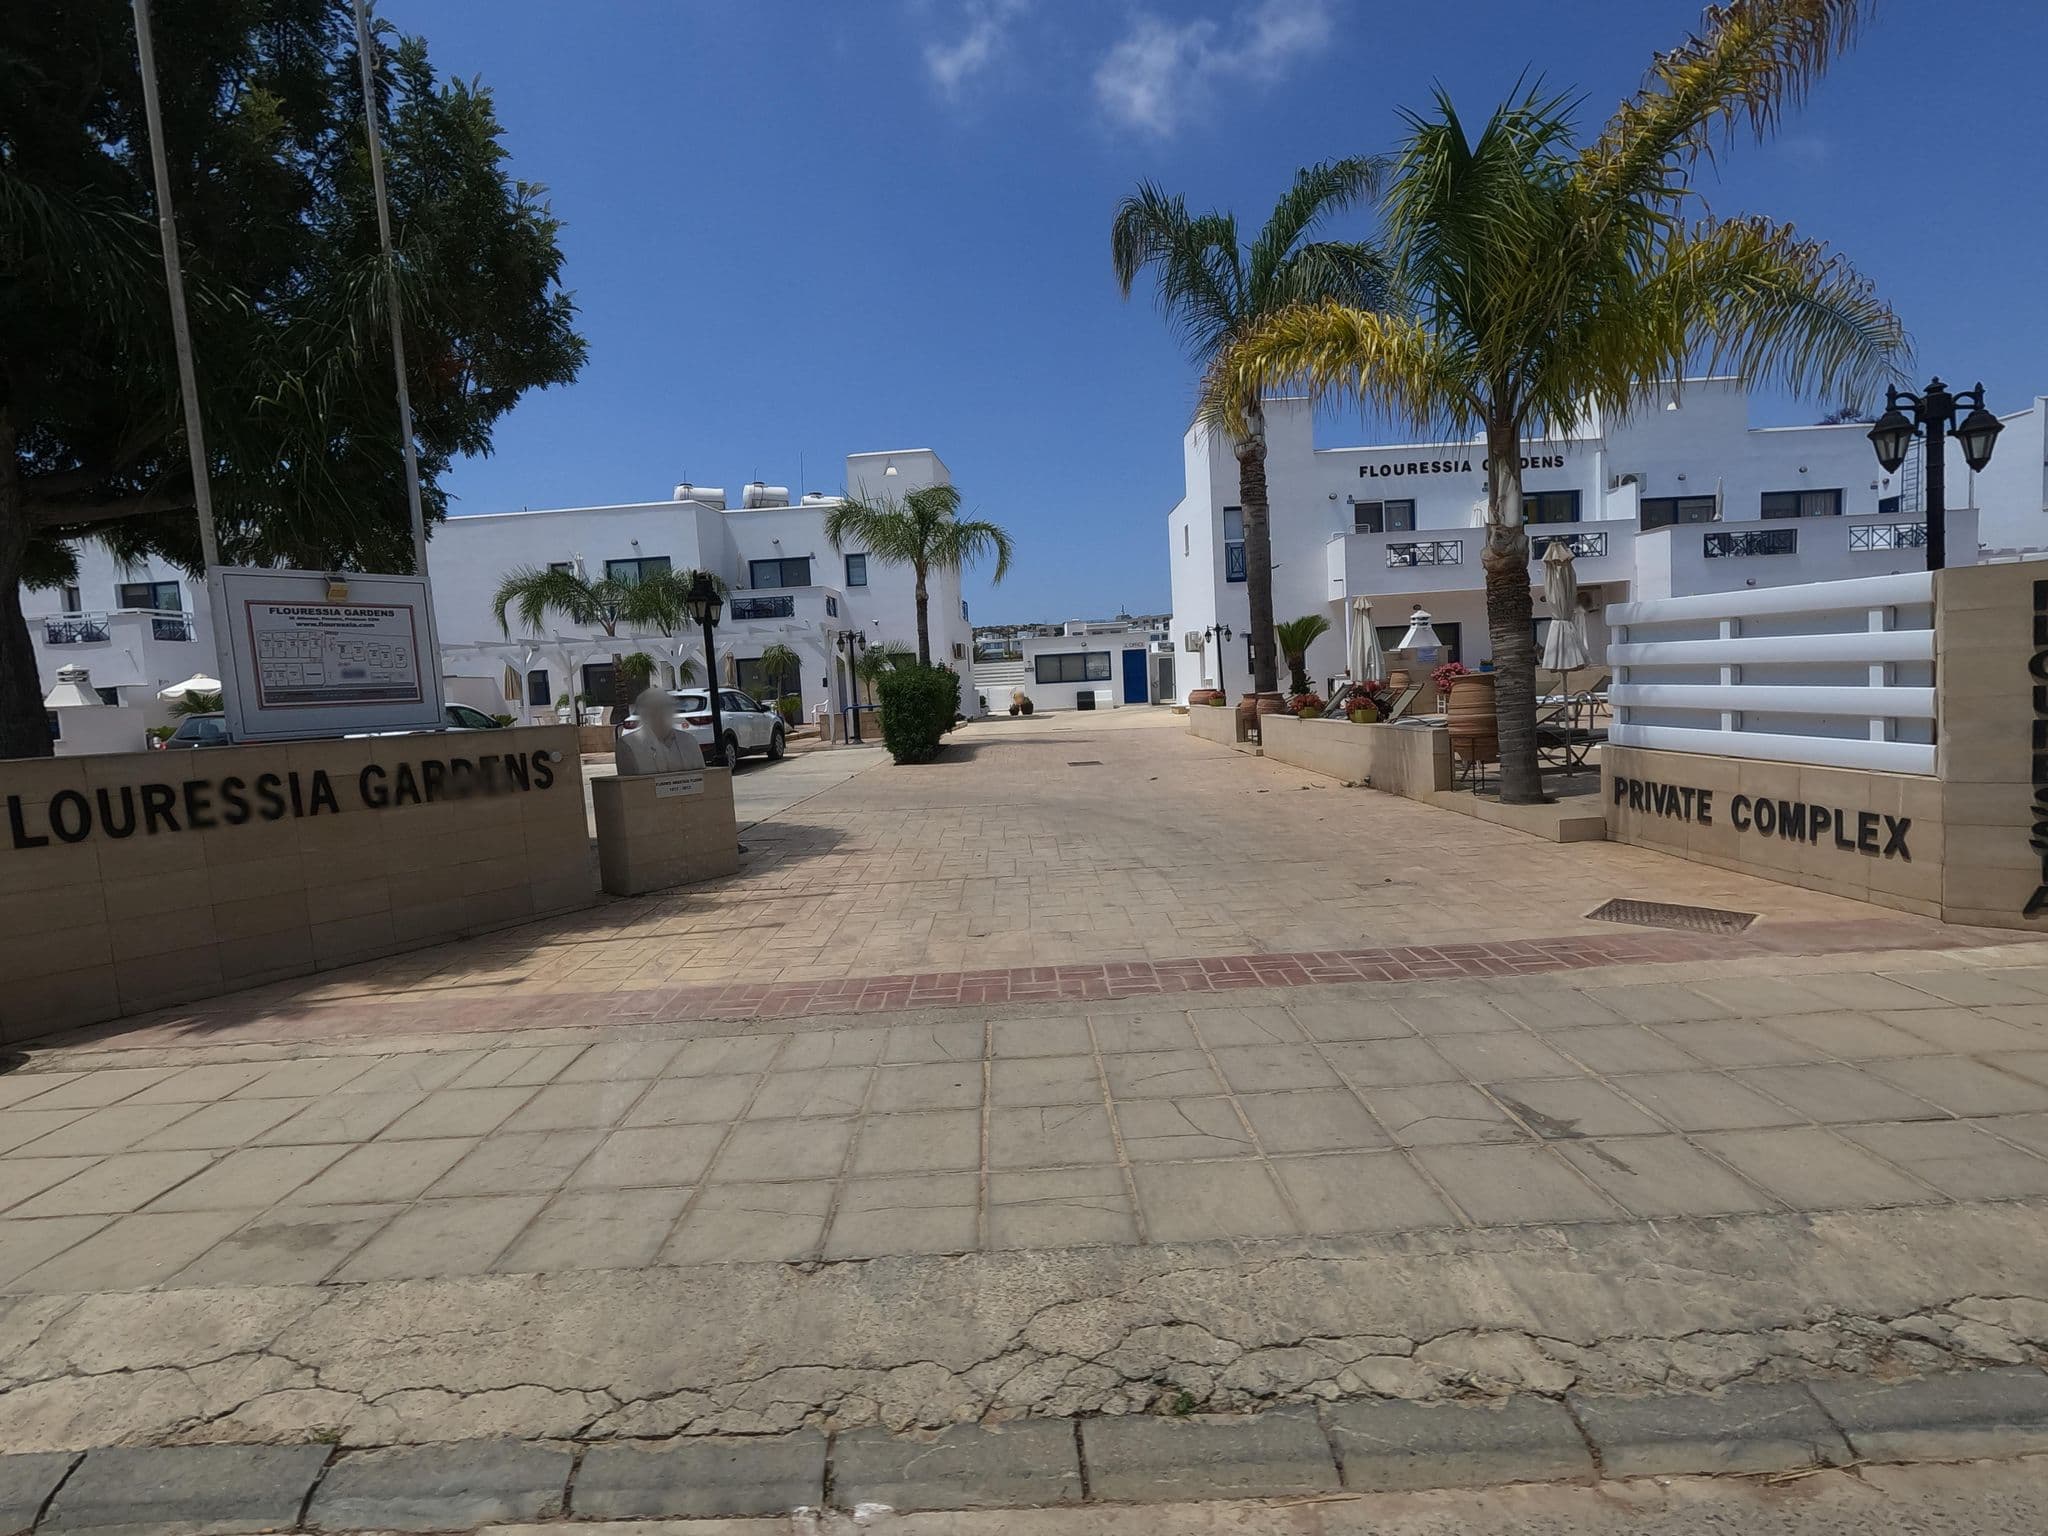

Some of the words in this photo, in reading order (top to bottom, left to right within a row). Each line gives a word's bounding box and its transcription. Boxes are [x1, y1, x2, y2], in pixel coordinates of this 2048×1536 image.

[1359, 460, 1472, 478] FLOURESSIA
[1482, 456, 1564, 472] DENS
[269, 607, 341, 616] FLOURESSIA
[344, 608, 395, 617] GARDENS
[7, 770, 340, 848] LOURESSIA
[1614, 776, 1713, 825] PRIVATE
[1731, 794, 1912, 862] COMPLEX
